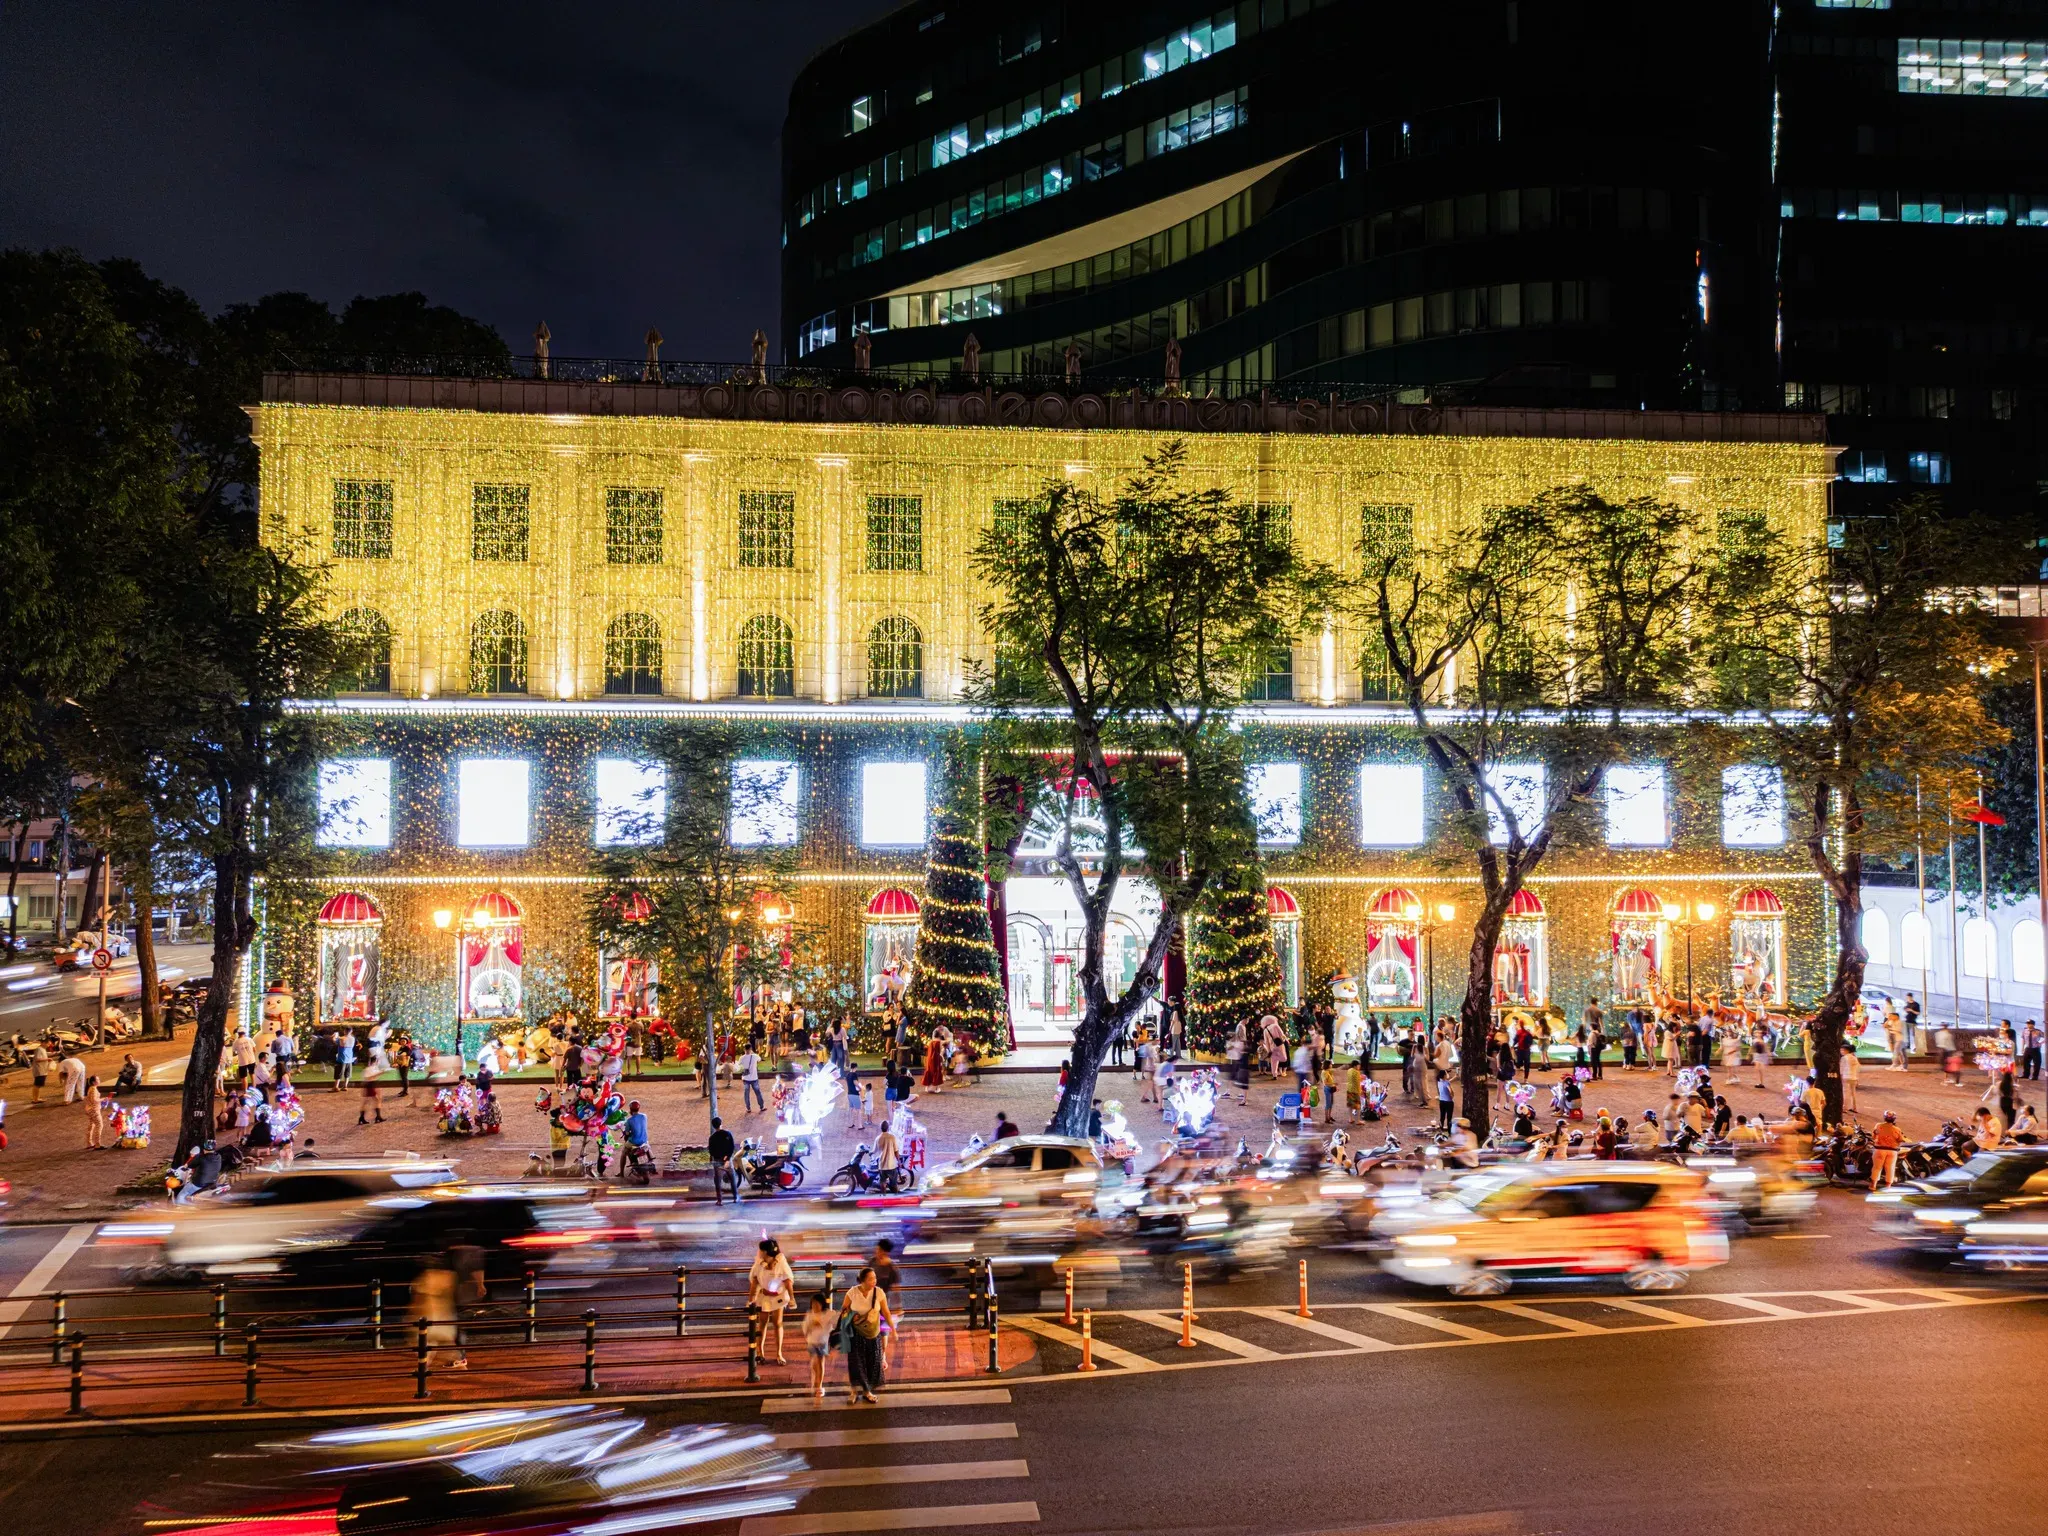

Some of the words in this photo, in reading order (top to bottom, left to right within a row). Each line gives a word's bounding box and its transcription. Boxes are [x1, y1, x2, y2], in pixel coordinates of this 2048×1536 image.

[700, 379, 937, 423] diamond
[958, 386, 1278, 432] department
[1295, 391, 1442, 434] store
